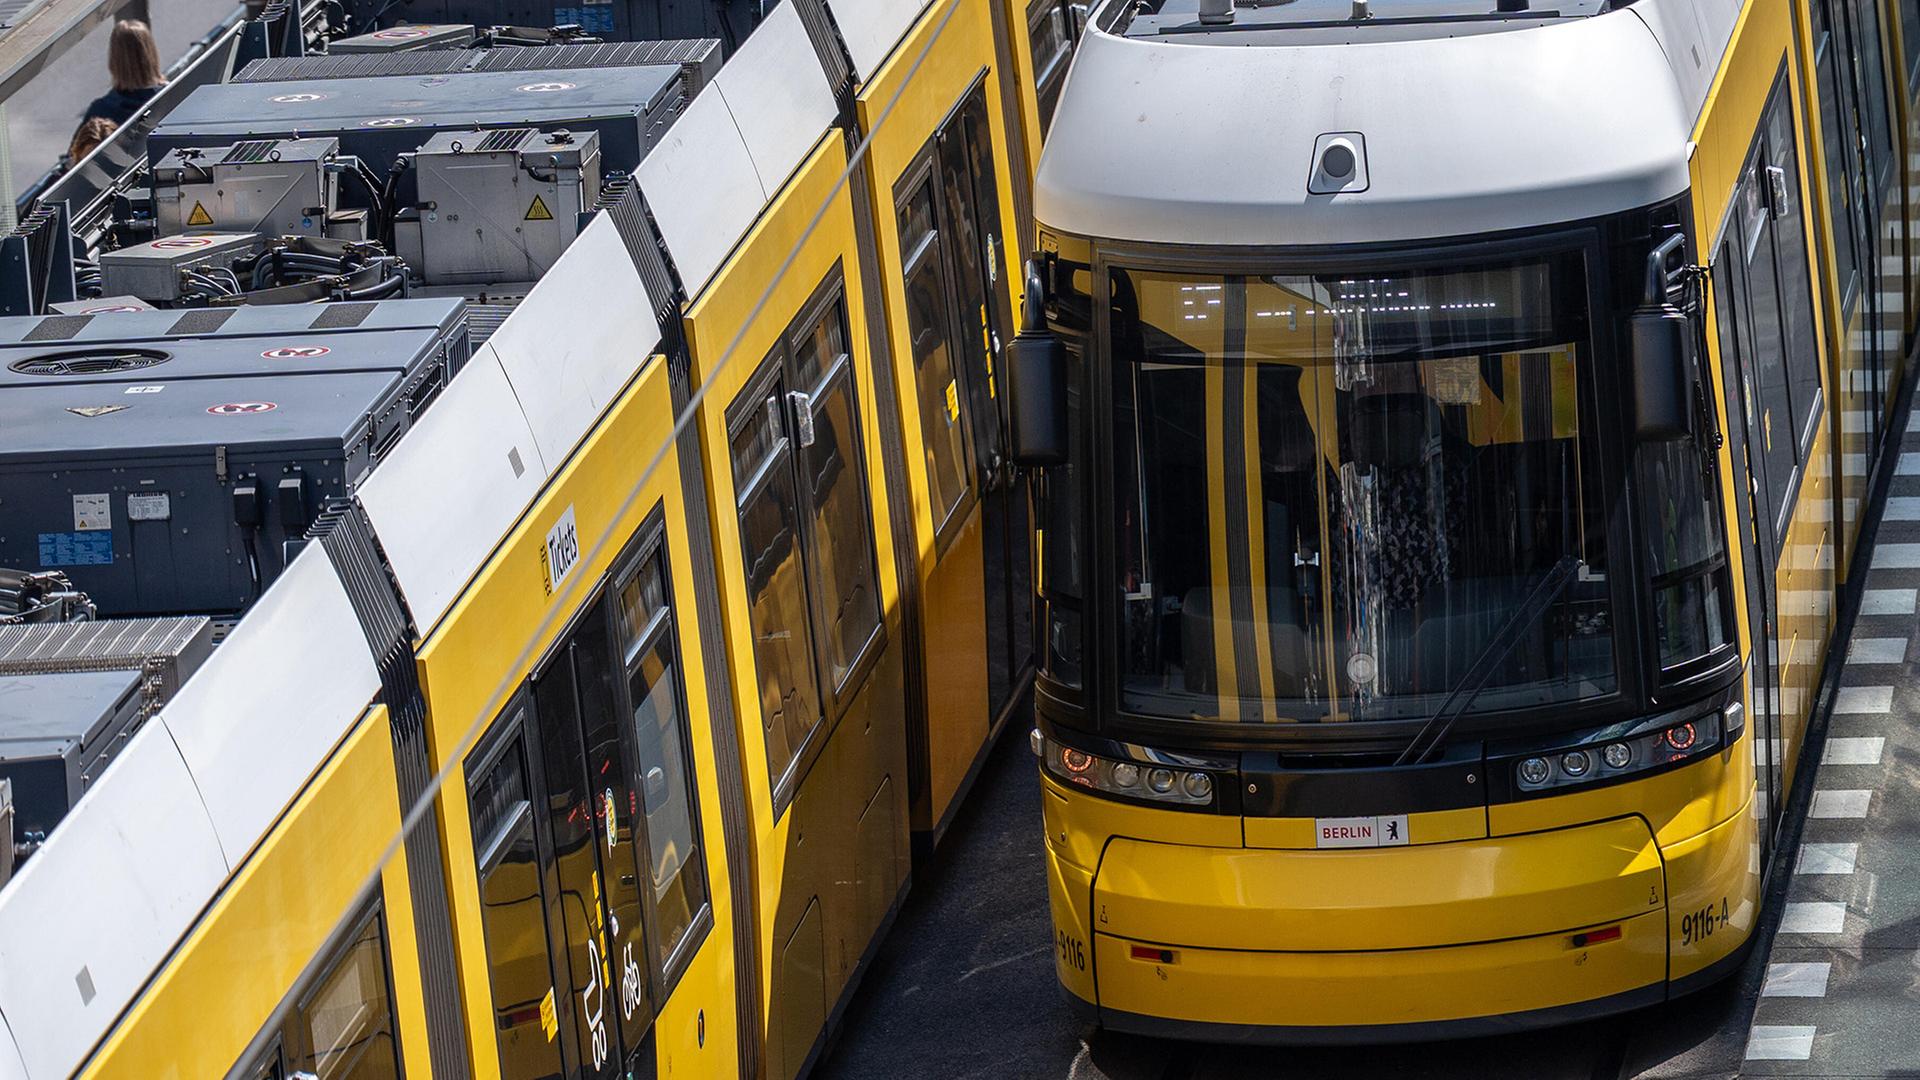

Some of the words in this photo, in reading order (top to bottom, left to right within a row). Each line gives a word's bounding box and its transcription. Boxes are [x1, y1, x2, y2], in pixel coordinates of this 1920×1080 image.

[549, 522, 577, 583] Tickets
[1322, 826, 1371, 839] BERLIN
[1682, 896, 1729, 946] 9116-A
